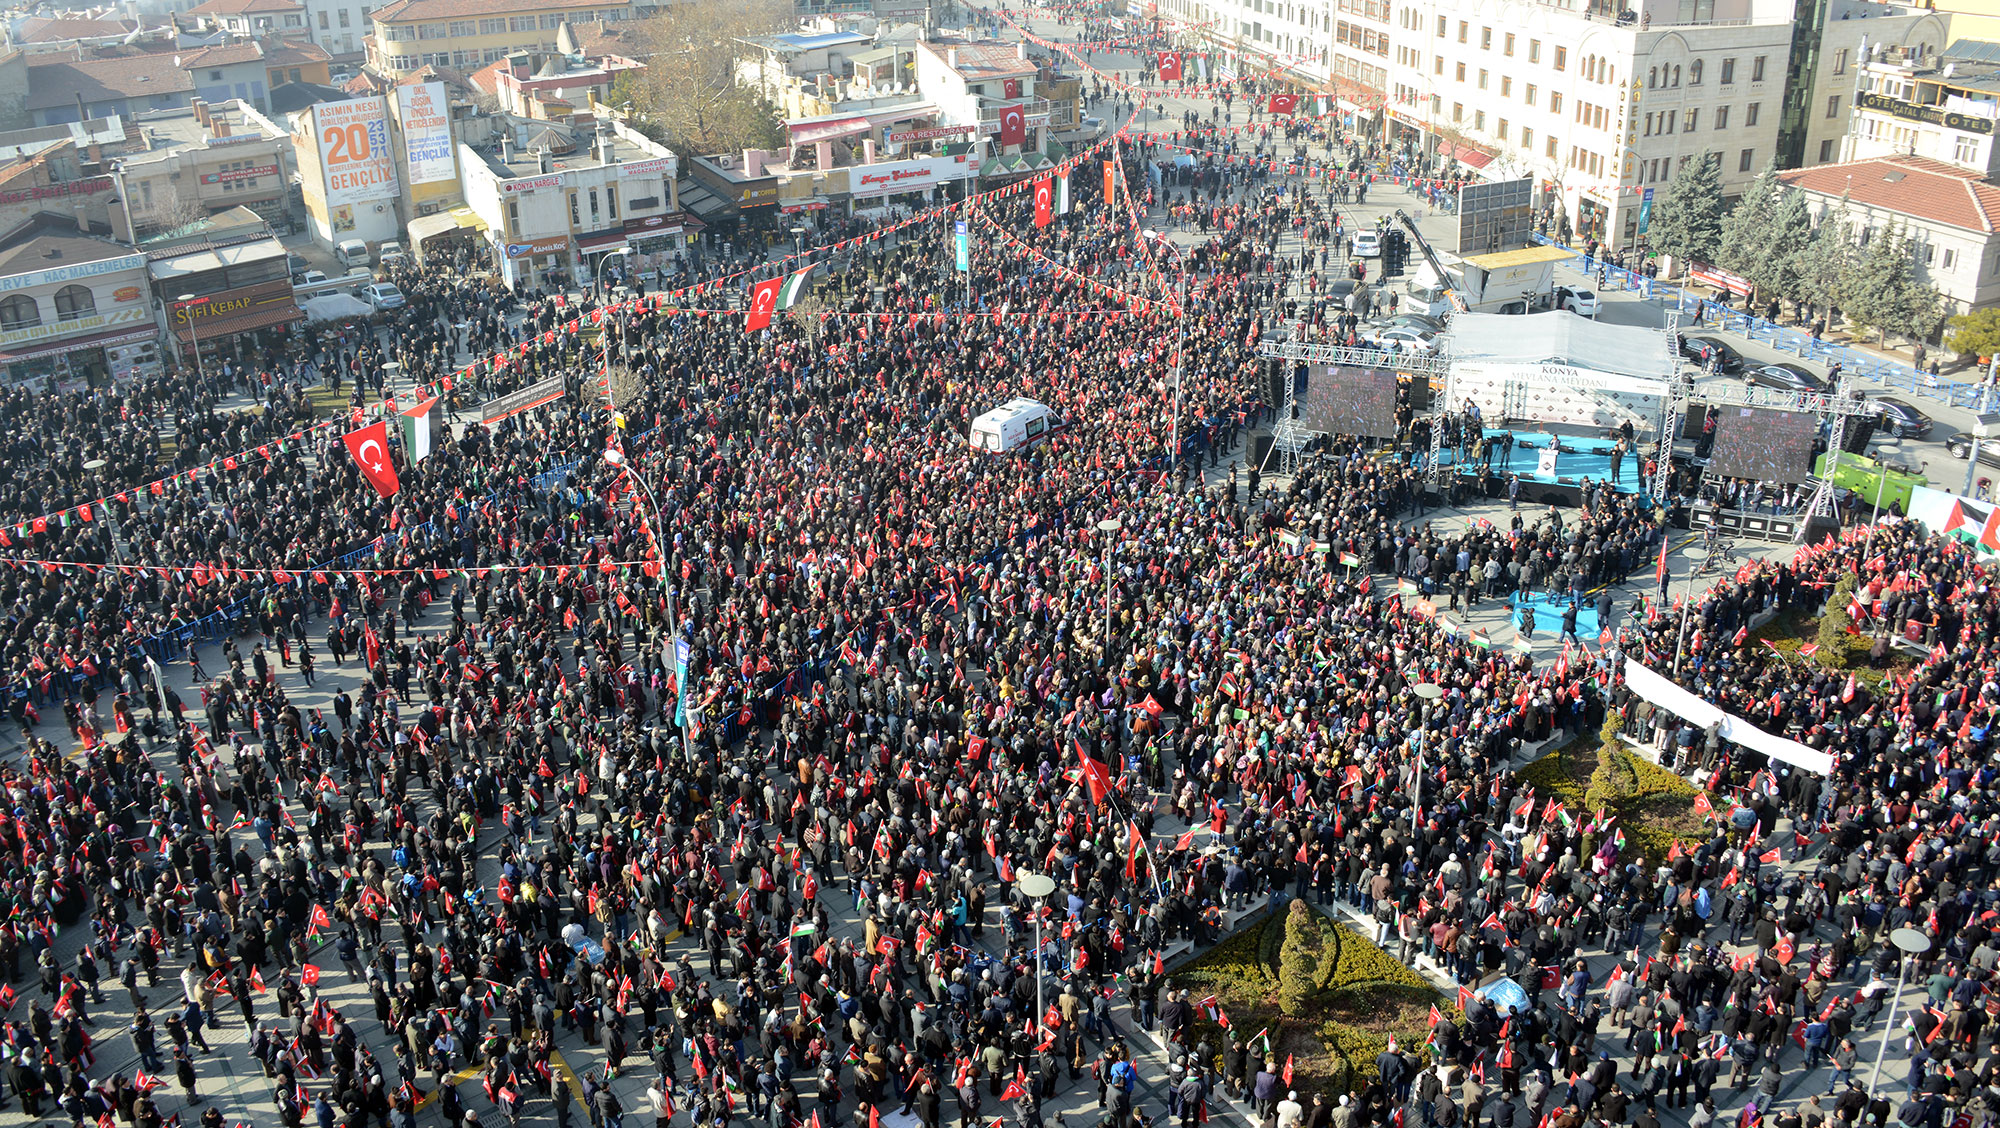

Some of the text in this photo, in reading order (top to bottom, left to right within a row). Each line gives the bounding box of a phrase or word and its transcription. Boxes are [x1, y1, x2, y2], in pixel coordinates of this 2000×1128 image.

[1893, 104, 1918, 117] ÇATAL
[368, 120, 384, 133] 23
[1950, 116, 1989, 131] OTEL
[369, 133, 386, 146] 53
[893, 126, 973, 141] DEVA RESTAURANT
[323, 123, 371, 165] 20
[371, 145, 388, 158] 71
[410, 146, 451, 162] GENÇLİK
[331, 167, 393, 190] GENÇLİK
[861, 174, 891, 185] Konya
[44, 269, 67, 283] HAC
[69, 255, 143, 278] MALZEMELERİ
[210, 297, 251, 316] KEBAP
[1542, 366, 1579, 377] KONYA
[1512, 371, 1608, 389] MEVLANA MEYDANI
